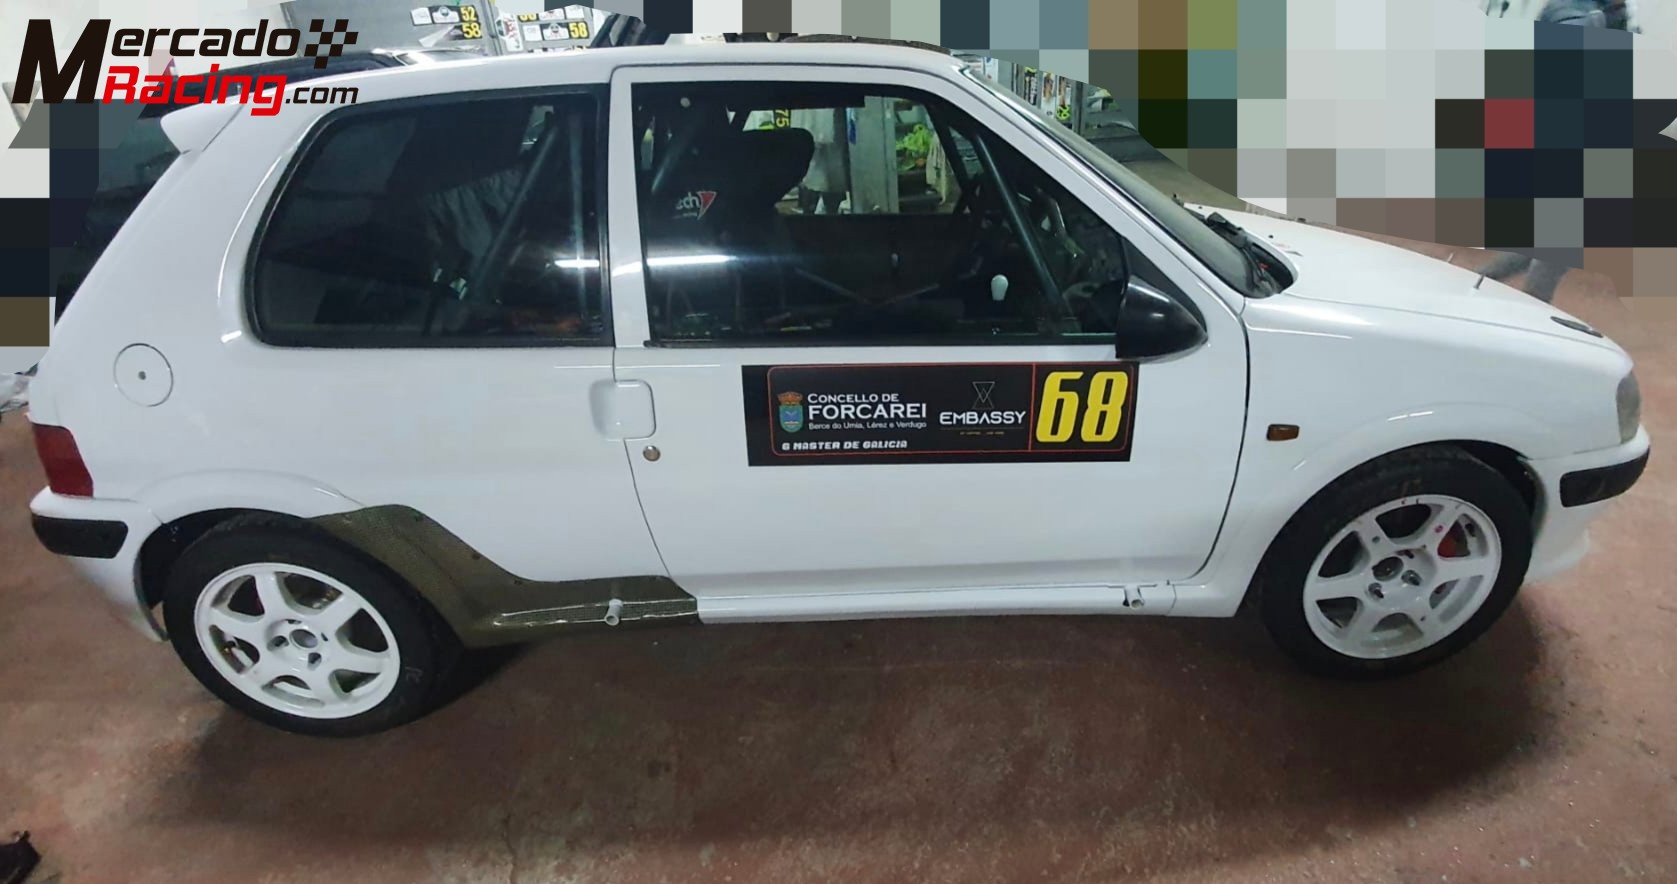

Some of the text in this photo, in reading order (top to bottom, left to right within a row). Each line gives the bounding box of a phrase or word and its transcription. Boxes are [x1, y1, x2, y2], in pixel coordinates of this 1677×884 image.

[460, 6, 477, 21] 52
[462, 22, 480, 39] 58
[568, 22, 589, 38] 58
[881, 393, 900, 402] DE
[808, 403, 927, 420] FORCAREI
[1036, 371, 1129, 442] 68
[896, 420, 927, 430] Verdugo
[939, 411, 1027, 425] EMBASSY
[792, 441, 841, 451] MASTER
[843, 440, 860, 449] DE
[862, 439, 908, 449] GALICIA
